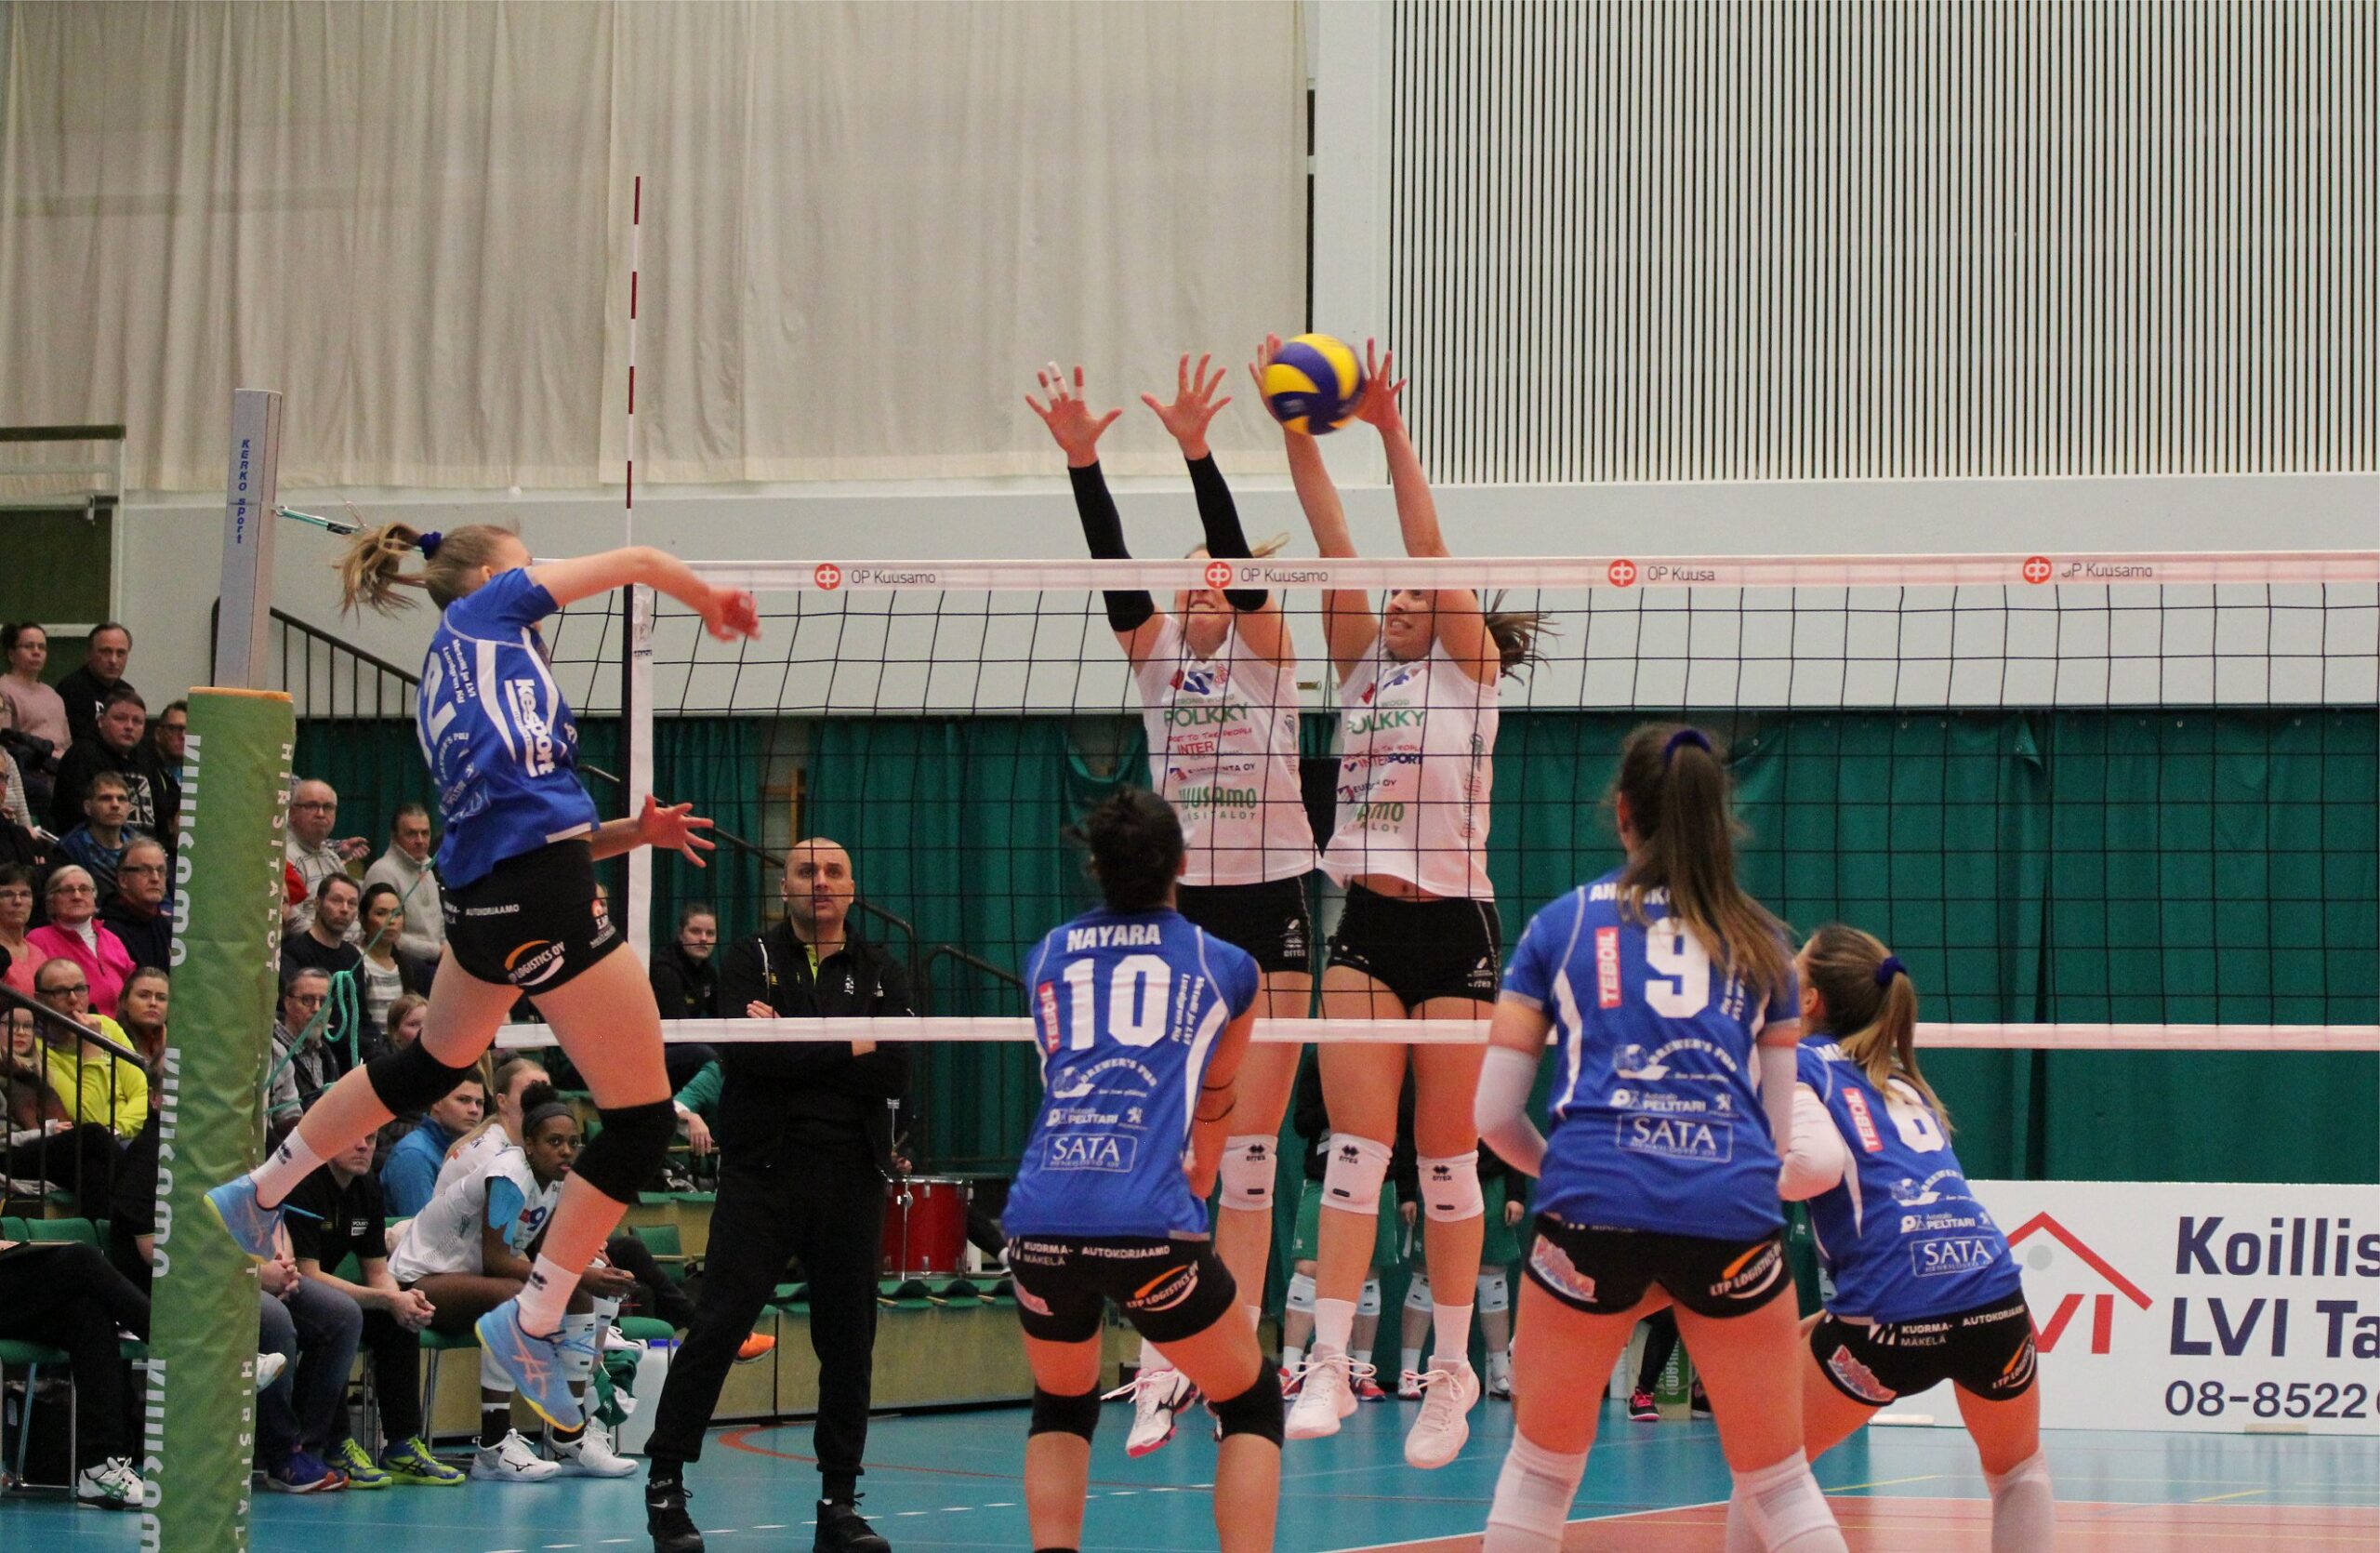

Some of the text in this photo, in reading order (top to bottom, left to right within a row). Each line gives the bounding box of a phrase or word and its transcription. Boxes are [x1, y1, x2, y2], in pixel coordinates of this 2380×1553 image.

[236, 439, 250, 544] KERKO sport
[851, 569, 937, 585] OP Kuusamo
[1240, 568, 1329, 583] OP Kuusamo
[1647, 566, 1716, 582] OP Kuusa
[2085, 563, 2153, 578] Kuusamo
[423, 650, 457, 746] 2
[265, 743, 293, 973] HIRSITALOT
[1066, 923, 1162, 952] NAYARA
[516, 949, 553, 979] LOGISTICS
[1597, 932, 1620, 1002] TEBOIL
[1645, 916, 1711, 1018] 9
[1063, 954, 1171, 1051] 10
[1632, 1116, 1717, 1151] SATA
[1052, 1136, 1120, 1162] SATA
[528, 1206, 547, 1232] 9
[1024, 1241, 1170, 1260] KUORMA- AUTOKORJAAMO
[1923, 1240, 1994, 1266] SATA
[2175, 1215, 2380, 1277] Koillis
[1710, 1281, 1732, 1296] LTP
[1900, 1334, 1947, 1347] MÄKELÄ
[1901, 1322, 1953, 1334] KUORMA-
[2170, 1296, 2380, 1359] LVI Ta
[2165, 1380, 2368, 1419] 08-8522
[234, 1361, 254, 1553] HIRSITAL
